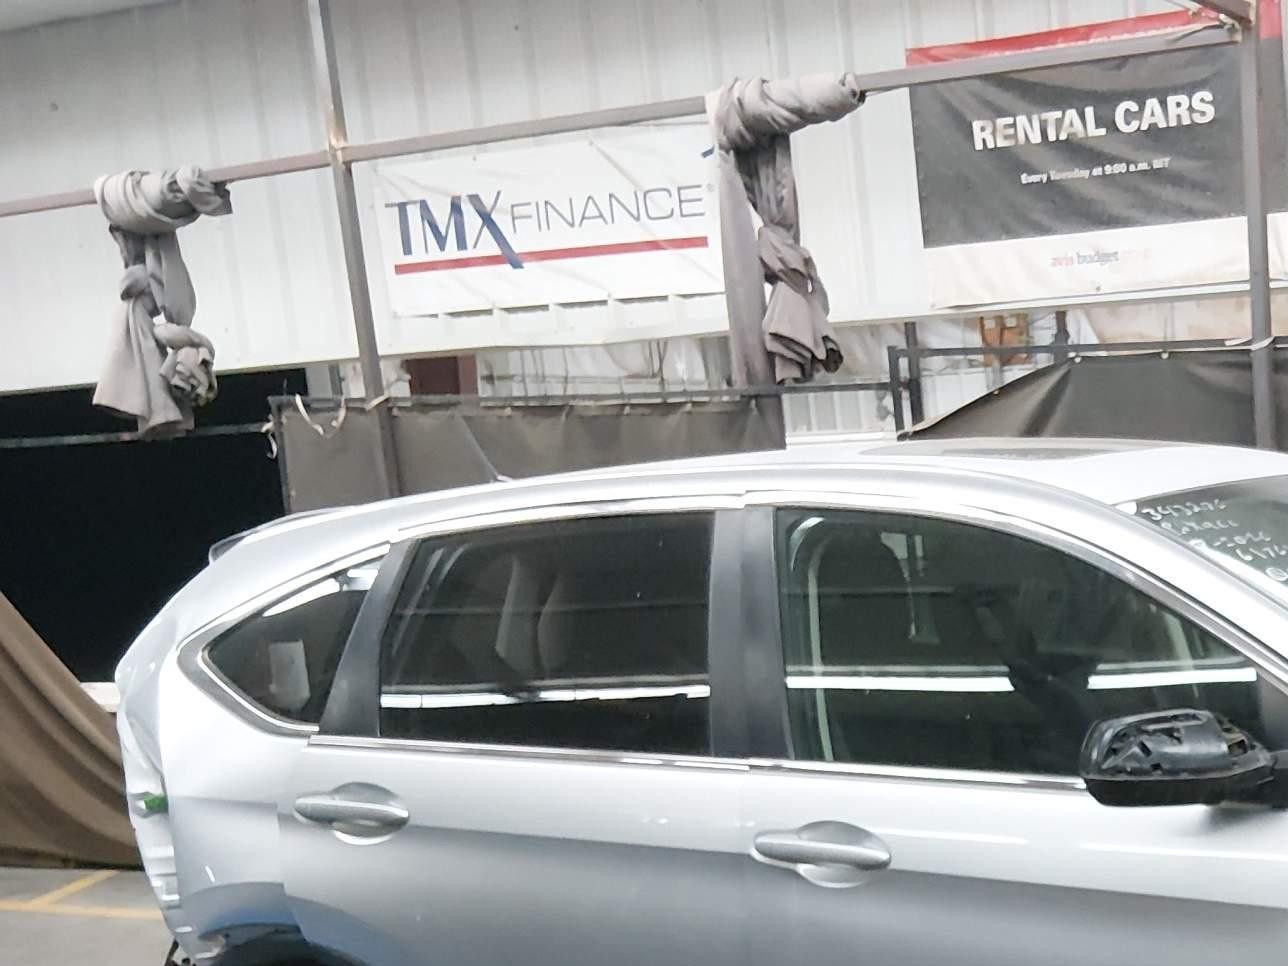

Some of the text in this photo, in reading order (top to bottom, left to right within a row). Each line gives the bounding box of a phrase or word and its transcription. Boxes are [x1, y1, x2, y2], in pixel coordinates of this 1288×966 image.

[971, 91, 1216, 151] RENTAL CARS
[384, 184, 706, 269] TMX FINANCE
